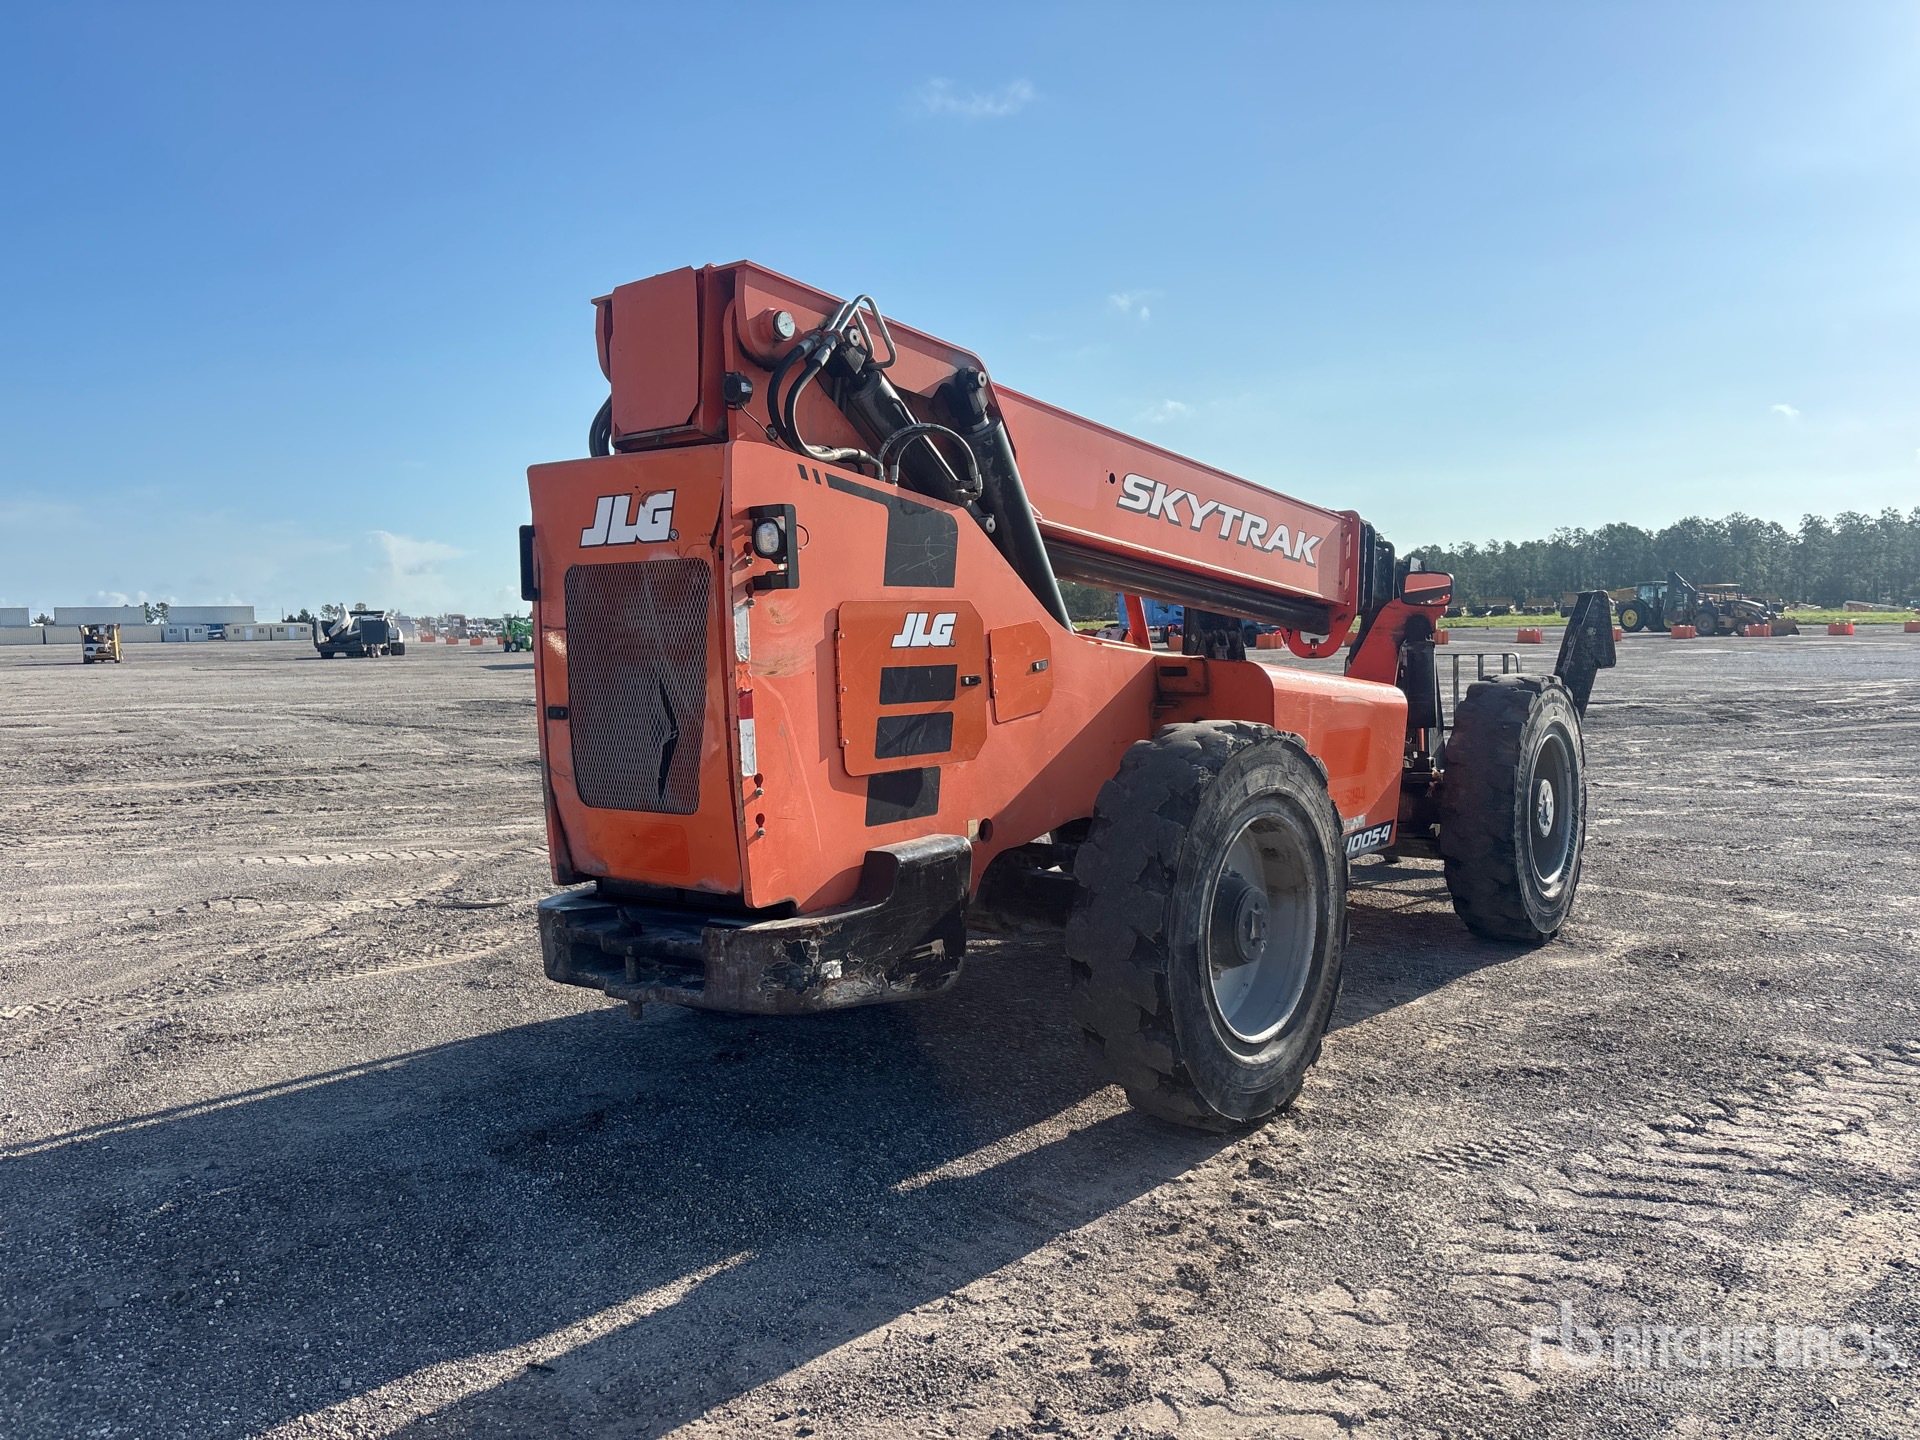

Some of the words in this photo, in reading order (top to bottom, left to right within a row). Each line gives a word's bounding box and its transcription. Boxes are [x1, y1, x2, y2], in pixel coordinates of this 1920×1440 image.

[579, 489, 676, 548] JLG
[1116, 473, 1322, 568] SKYTRAK
[890, 612, 958, 649] JLG
[1346, 824, 1391, 853] 10054
